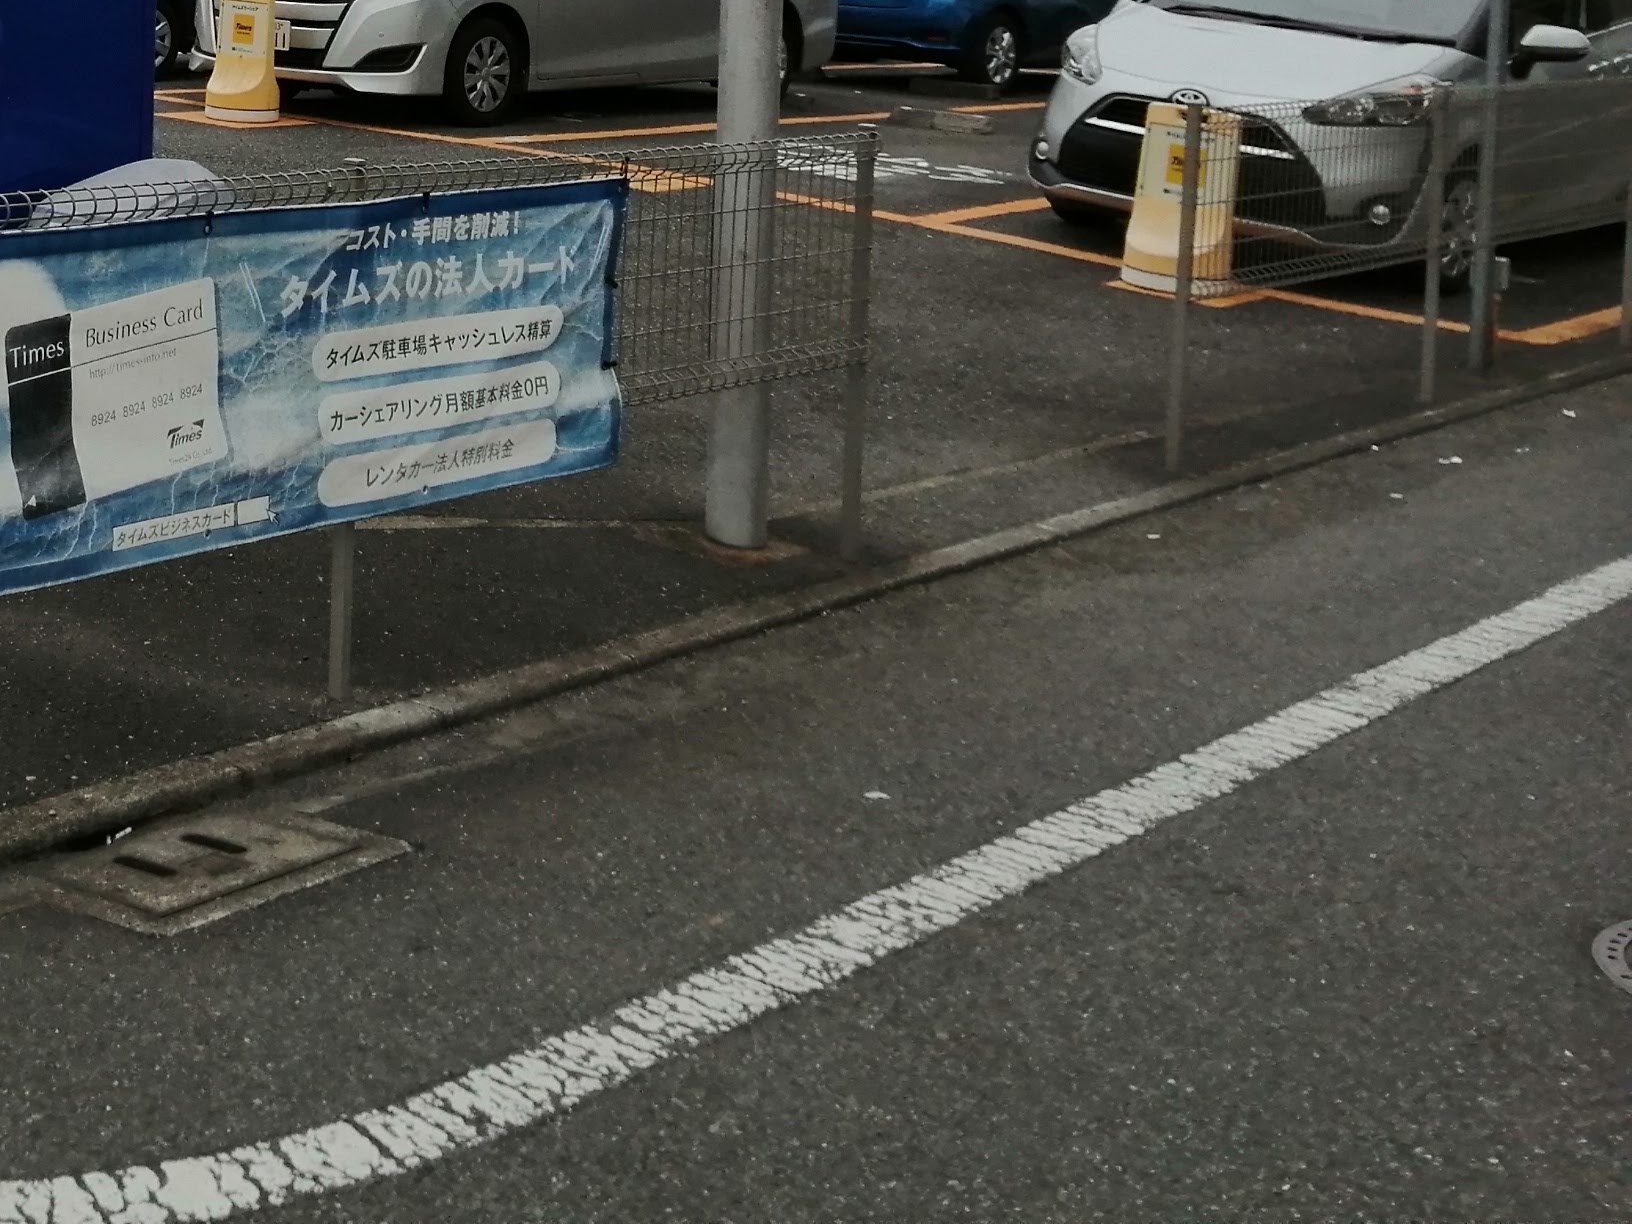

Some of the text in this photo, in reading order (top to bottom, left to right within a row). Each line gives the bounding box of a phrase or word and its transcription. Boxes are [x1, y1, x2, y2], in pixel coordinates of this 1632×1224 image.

[279, 246, 577, 318] タイムズの法人カード
[86, 298, 204, 348] Business Card
[327, 319, 552, 369] タイムズ駐車場キャッシュレス精算
[9, 341, 65, 368] Times
[91, 383, 203, 426] 8924 8924 8924 8924
[331, 376, 549, 432] カーシェアリング月額基本料金0円
[170, 430, 202, 449] Times
[366, 439, 515, 487] レンタカー法人特別料金
[118, 509, 230, 546] タイムズビジネスカード
